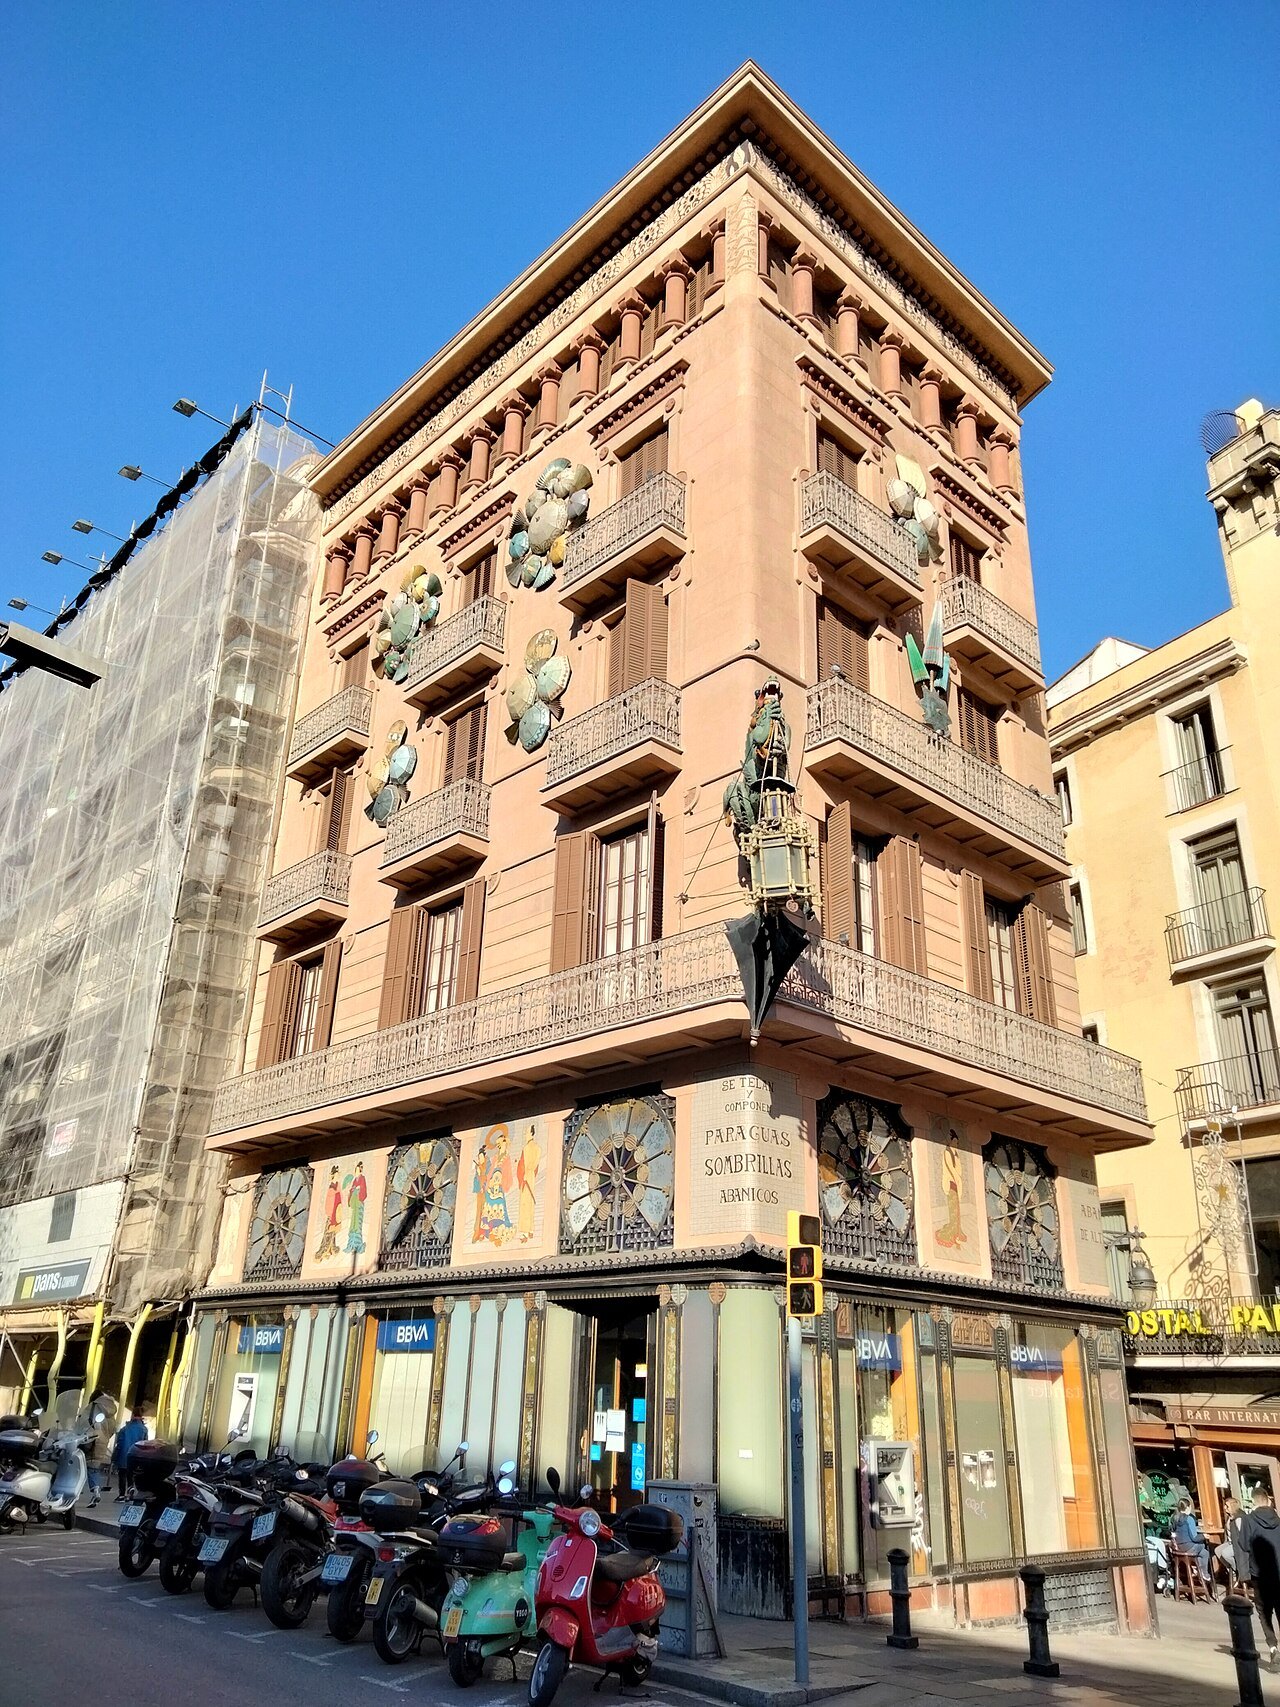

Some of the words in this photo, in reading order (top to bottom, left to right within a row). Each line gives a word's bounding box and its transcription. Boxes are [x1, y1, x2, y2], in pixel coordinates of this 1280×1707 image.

[722, 1079, 735, 1092] SE
[740, 1077, 774, 1093] TELAN
[746, 1090, 753, 1098] Y
[724, 1101, 772, 1113] COMPONEN
[705, 1125, 791, 1147] PARAGUAS
[704, 1153, 792, 1178] SOMBRILLAS
[719, 1187, 779, 1205] ABANICOS
[32, 1272, 60, 1298] pans
[255, 1330, 281, 1346] BBVA
[396, 1323, 428, 1343] BBVA
[1010, 1345, 1043, 1362] BBVA
[1186, 1409, 1211, 1421] BAR
[1217, 1410, 1280, 1423] INTERNAT
